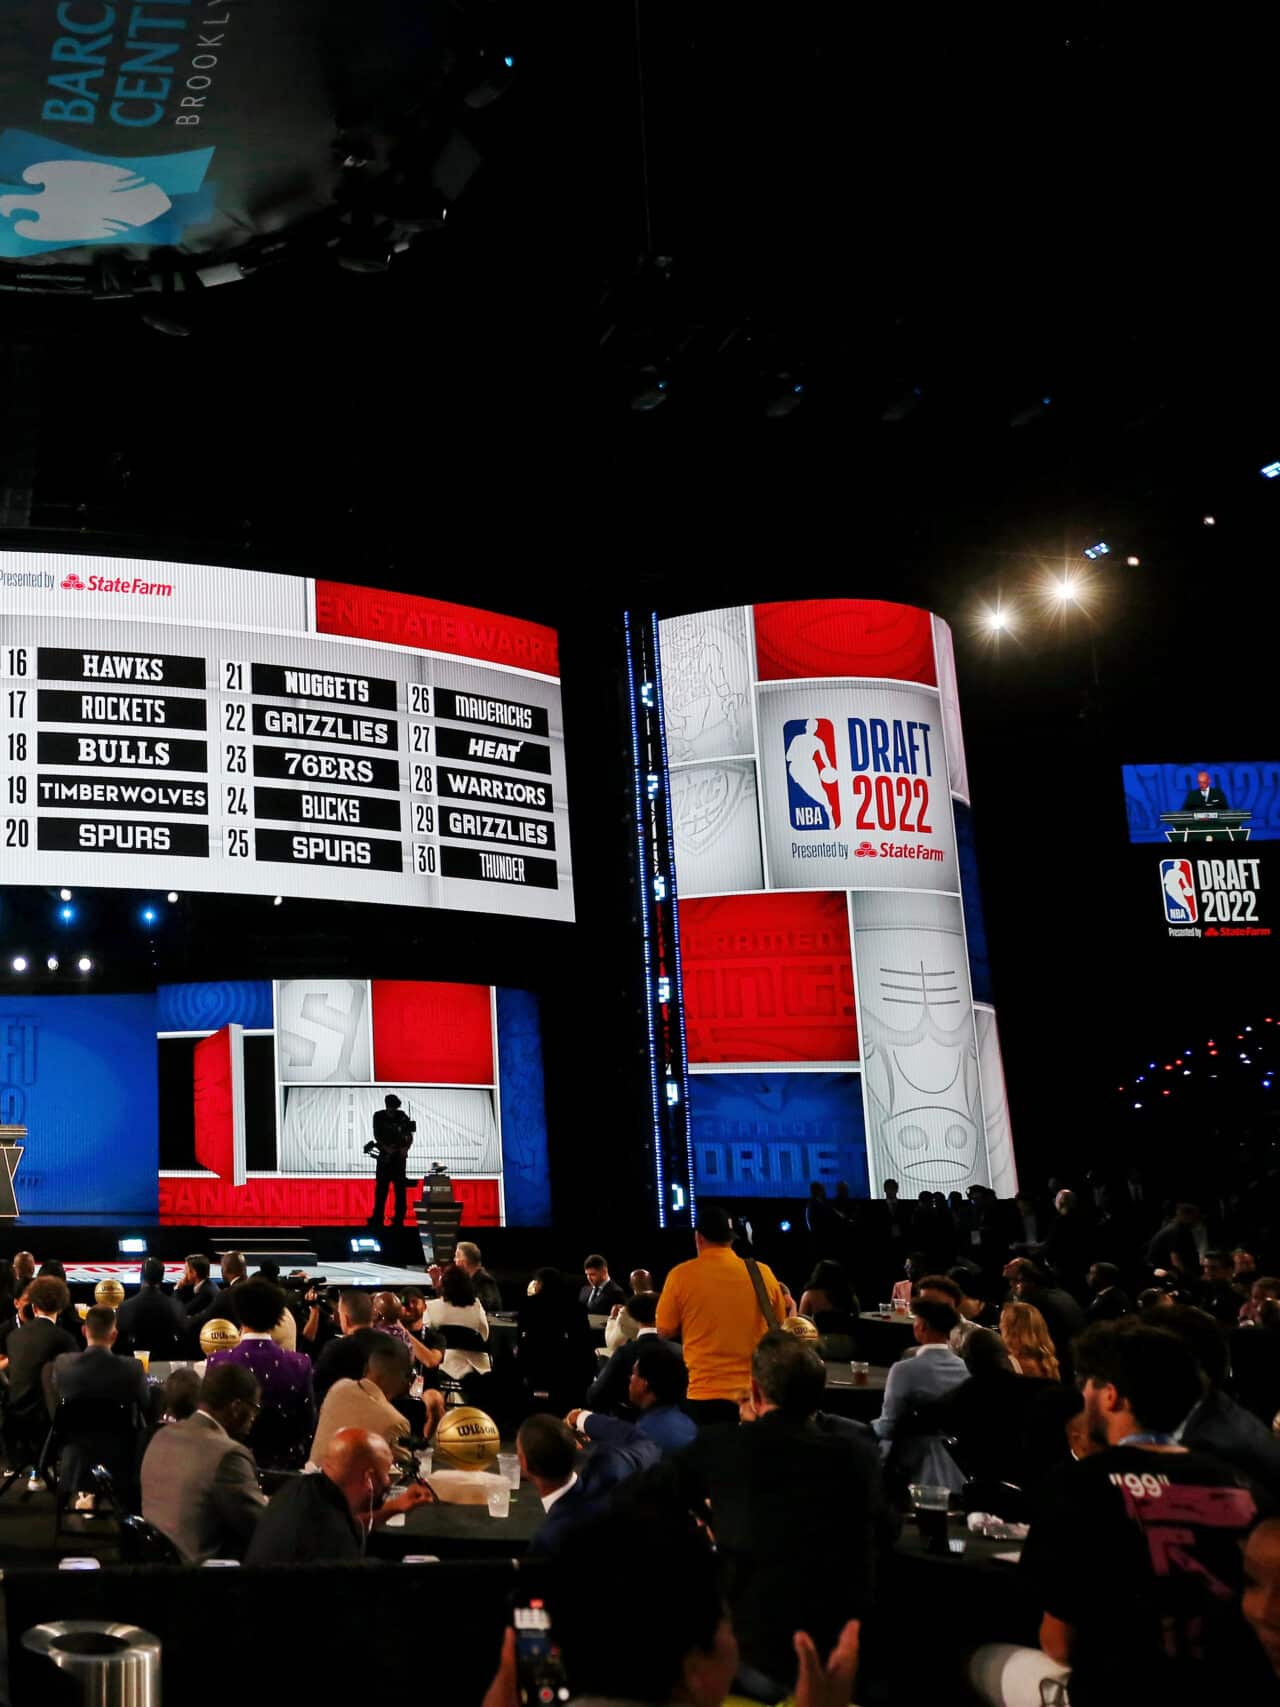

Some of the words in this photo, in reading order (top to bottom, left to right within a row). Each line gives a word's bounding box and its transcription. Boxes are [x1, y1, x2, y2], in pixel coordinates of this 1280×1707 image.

[109, 0, 192, 127] CENT
[43, 572, 55, 589] by
[8, 648, 27, 677] 16
[82, 654, 164, 681] HAWKS
[226, 662, 243, 691] 21
[284, 670, 369, 703] NUGGETS
[8, 690, 27, 719] 17
[81, 695, 166, 724] ROCKETS
[225, 703, 246, 732] 22
[264, 710, 388, 744] GRIZZLIES
[412, 685, 430, 714] 26
[455, 694, 532, 729] MAVERICKS
[7, 732, 27, 762] 18
[77, 738, 170, 766] BULLS
[413, 725, 430, 753] 27
[469, 738, 523, 762] HEAT
[848, 717, 931, 777] DRAFT
[226, 744, 247, 774] 23
[284, 752, 374, 783] 76ERS
[7, 775, 27, 805] 19
[39, 782, 206, 807] TIMBERWOLVES
[414, 765, 433, 793] 28
[447, 773, 546, 806] WARRIORS
[853, 774, 933, 834] 2022
[227, 786, 248, 816] 24
[301, 794, 360, 823] BUCKS
[796, 807, 822, 826] NBA
[6, 818, 29, 848] 20
[79, 823, 171, 850] SPURS
[416, 804, 434, 833] 29
[449, 812, 548, 845] GRIZZLIES
[227, 828, 249, 858] 25
[292, 836, 371, 865] SPURS
[417, 845, 436, 874] 30
[479, 852, 526, 882] THUNDER
[792, 842, 836, 859] Presented
[838, 842, 848, 860] by
[1197, 859, 1261, 890] DRAFT
[1202, 890, 1259, 922] 2022
[1169, 927, 1193, 937] Presented
[457, 1423, 496, 1437] Wilson
